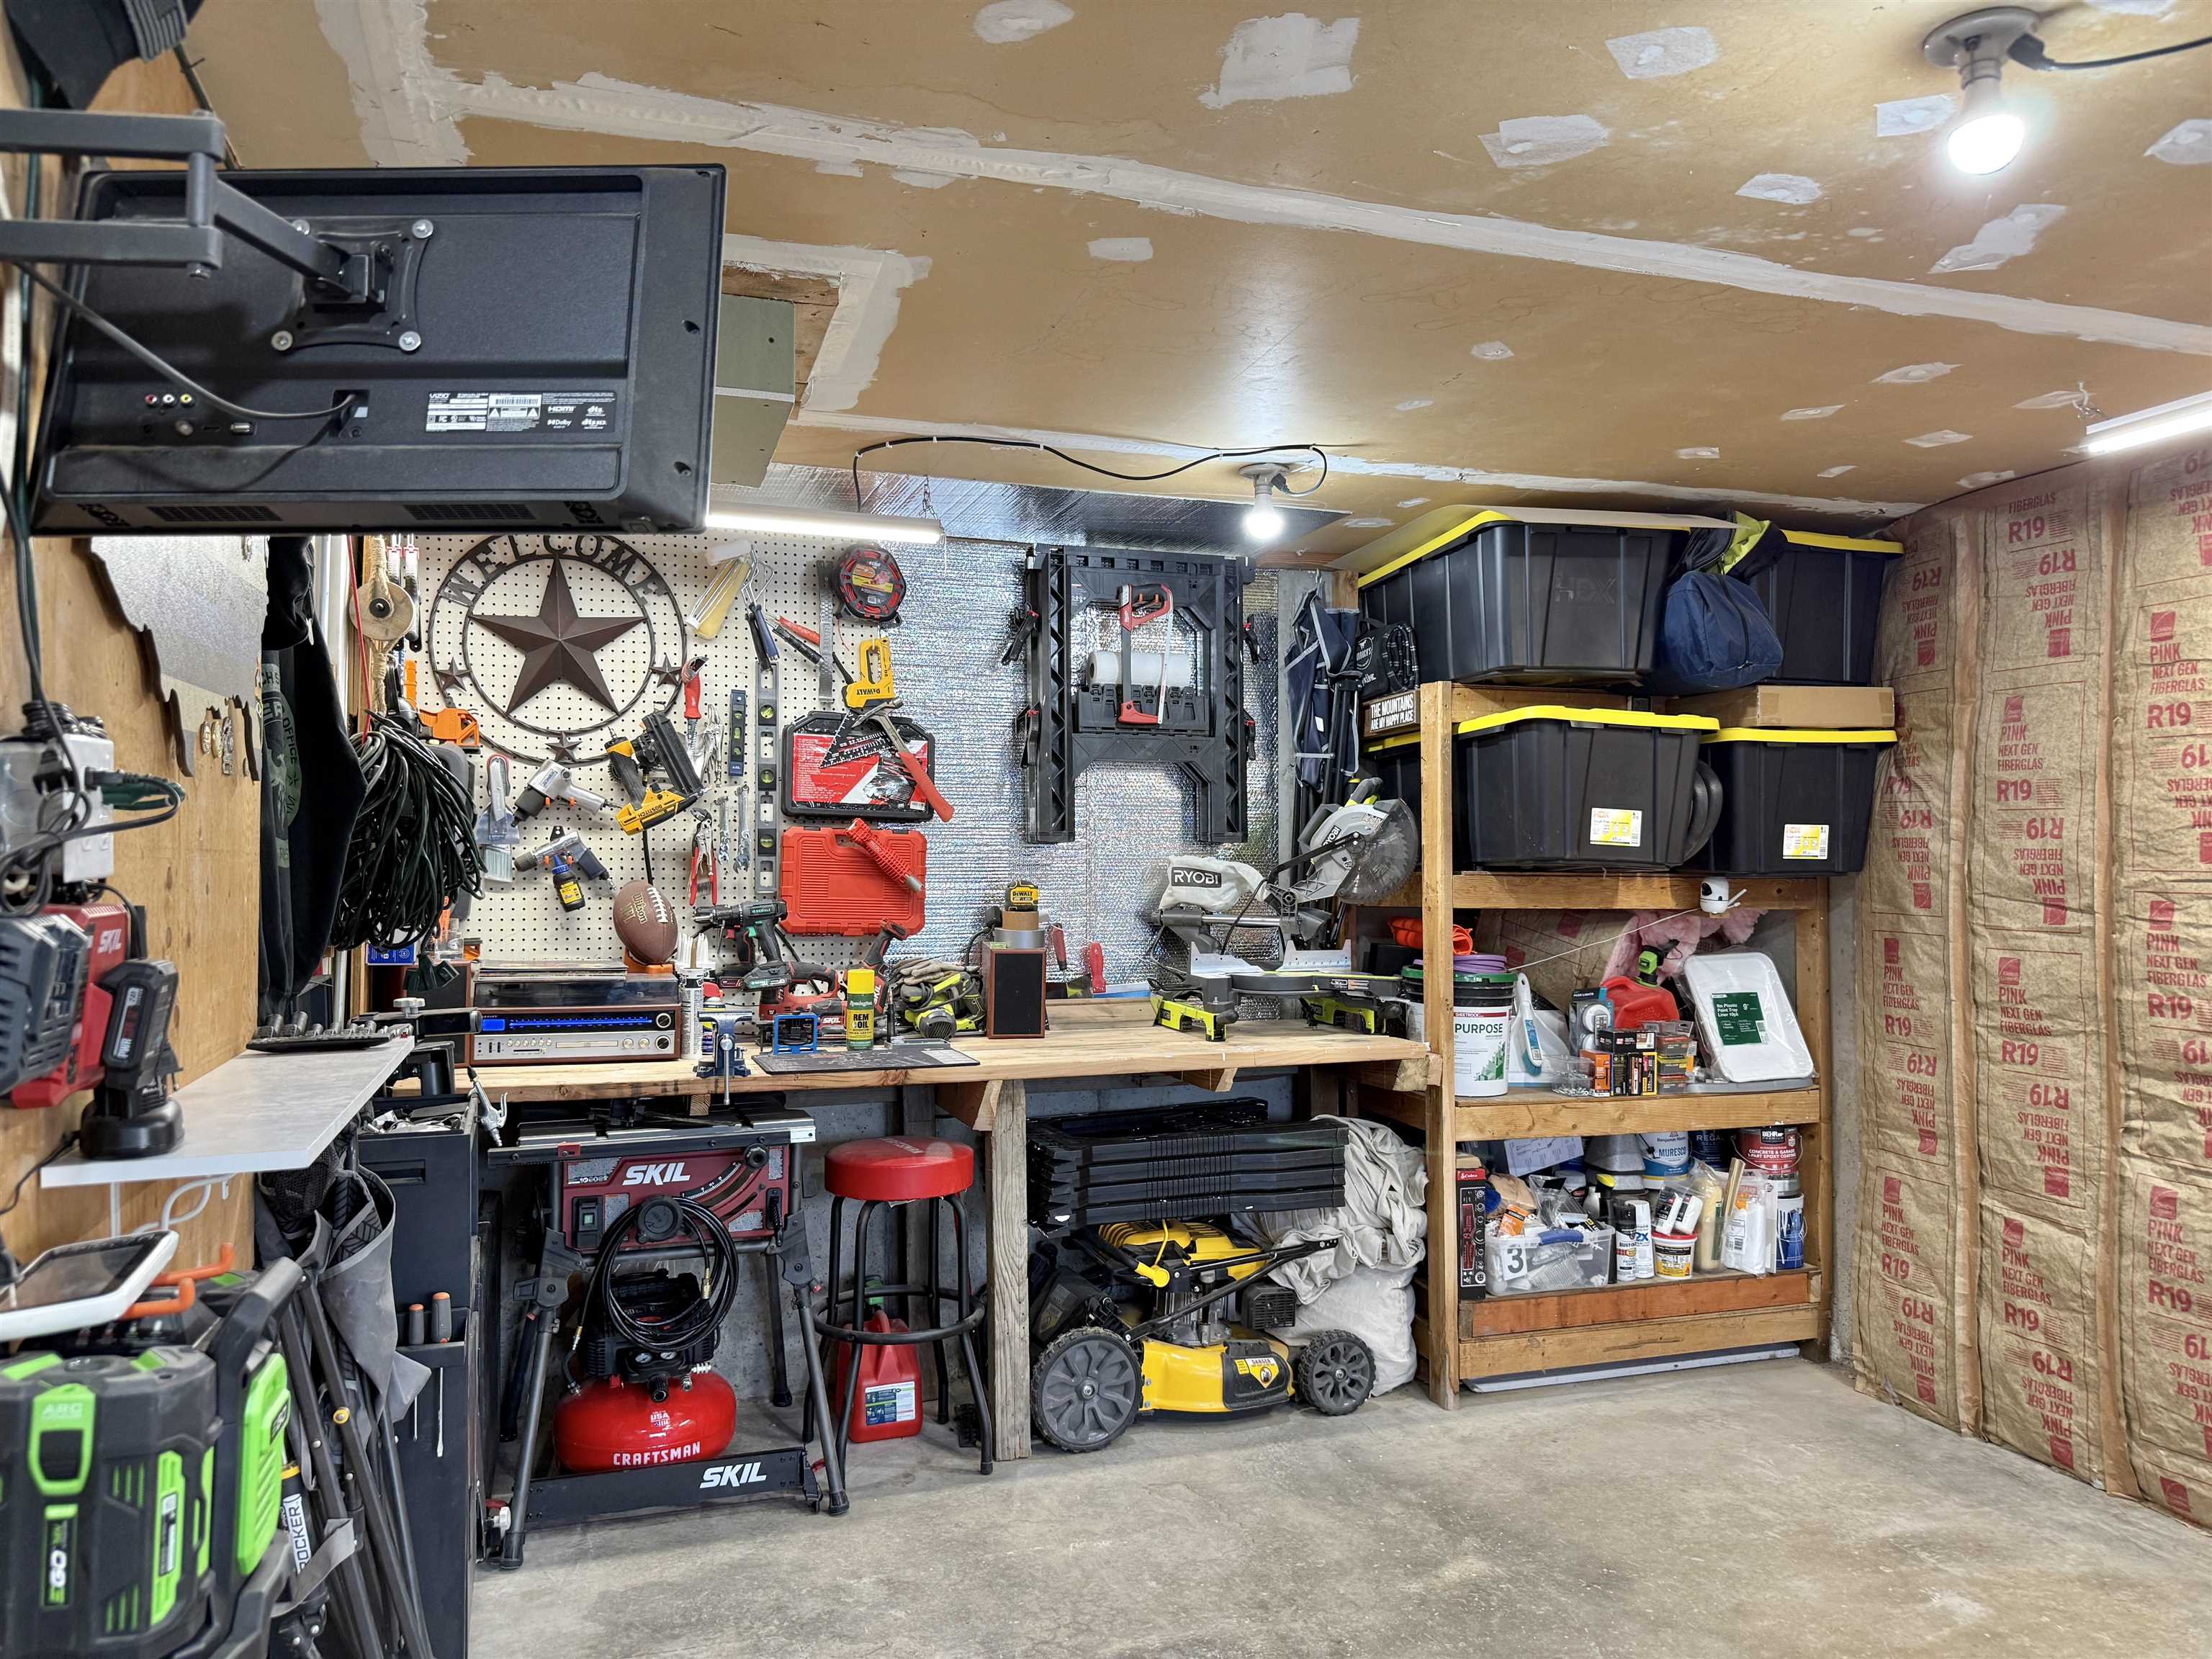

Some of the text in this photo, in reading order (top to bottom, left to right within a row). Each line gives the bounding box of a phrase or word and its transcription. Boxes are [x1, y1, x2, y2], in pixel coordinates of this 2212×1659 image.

[2168, 480, 2212, 502] ERGLAS
[2008, 516, 2045, 544] R19
[2191, 515, 2212, 534] NK
[2038, 549, 2077, 575] R19
[1912, 567, 1941, 591] R19
[2026, 580, 2077, 598] FIBERGLAS
[2031, 594, 2074, 611] NEXT GEN
[2044, 612, 2072, 628] PINK
[1914, 622, 1936, 639] PINK
[2150, 642, 2180, 663] PINK
[2152, 662, 2198, 678] NEXT GEN
[2150, 678, 2205, 695] FIBERGLAS
[1371, 694, 1413, 719] THE MOUNTAINS
[1401, 709, 1413, 723] PLACE
[2147, 701, 2191, 728] R19
[2001, 724, 2027, 741] PINK
[1999, 743, 2039, 756] NEXT GEN
[2181, 744, 2211, 769] 19
[1997, 758, 2045, 771] FIBERGLAS
[1997, 779, 2032, 801] R19
[2167, 778, 2212, 792] ERGLAS
[2175, 795, 2196, 808] GEN
[1899, 809, 1932, 830] R19
[2026, 817, 2064, 840] R19
[2191, 811, 2212, 828] NK
[2013, 848, 2062, 860] FIBERGLAS
[1173, 869, 1219, 884] RYOBI
[1907, 866, 1930, 881] PINK
[2019, 864, 2063, 876] NEXT GEN
[2033, 879, 2064, 894] PINK
[632, 893, 647, 924] Wilson
[99, 929, 122, 954] SKIL
[2146, 934, 2180, 951] PINK
[2146, 956, 2198, 970] NEXT GEN
[1884, 967, 1903, 981] PINK
[2146, 971, 2207, 988] FIBERGLAS
[1883, 982, 1913, 996] NEXT GEN
[1999, 988, 2026, 1004] PINK
[1884, 997, 1919, 1010] FIBERGLAS
[2147, 993, 2193, 1020] R19
[2000, 1007, 2041, 1021] NEXT GEN
[1455, 1023, 1503, 1033] PURPOSE
[1885, 1014, 1912, 1037] R19
[2000, 1020, 2051, 1036] FIBERGLAS
[2002, 1041, 2038, 1064] R19
[2183, 1040, 2211, 1065] 19
[1907, 1053, 1937, 1076] R19
[1897, 1079, 1935, 1096] FIBERGLAS
[2029, 1083, 2069, 1110] R19
[1902, 1094, 1935, 1110] NEXT GEN
[1912, 1110, 1935, 1128] PINK
[2018, 1112, 2069, 1131] FIBERGLAS
[2024, 1129, 2068, 1146] NEXT GEN
[1658, 1146, 1686, 1157] MURESCO
[2037, 1146, 2069, 1165] PINK
[623, 1163, 691, 1186] SKIL
[1882, 1205, 1904, 1220] PINK
[1636, 1233, 1649, 1241] 2X
[1881, 1221, 1914, 1239] NEXT GEN
[2148, 1220, 2182, 1244] PINK
[1882, 1236, 1919, 1256] FIBERGLAS
[2147, 1241, 2198, 1264] NEXT GEN
[1507, 1248, 1524, 1273] 3
[1881, 1253, 1910, 1279] R19
[2002, 1249, 2030, 1268] PINK
[2002, 1267, 2044, 1287] NEXT GEN
[2149, 1259, 2204, 1284] FIBERGLAS
[2003, 1282, 2051, 1305] FIBERGLAS
[2149, 1280, 2193, 1312] R19
[1902, 1297, 1933, 1324] R19
[2005, 1302, 2038, 1331] R19
[1894, 1321, 1933, 1344] FIBERGLAS
[1899, 1337, 1933, 1359] NEXT GEN
[2185, 1334, 2211, 1360] 19
[1910, 1356, 1934, 1375] PINK
[2031, 1351, 2072, 1381] R19
[2169, 1362, 2211, 1387] ERGLAS
[2022, 1377, 2072, 1402] FIBERGLAS
[2177, 1383, 2200, 1399] GEN
[2028, 1394, 2072, 1419] NEXT GEN
[2195, 1403, 2212, 1427] NK
[2043, 1414, 2072, 1438] PINK
[613, 1441, 701, 1466] CRAFTSMAN
[700, 1462, 767, 1488] SKIL
